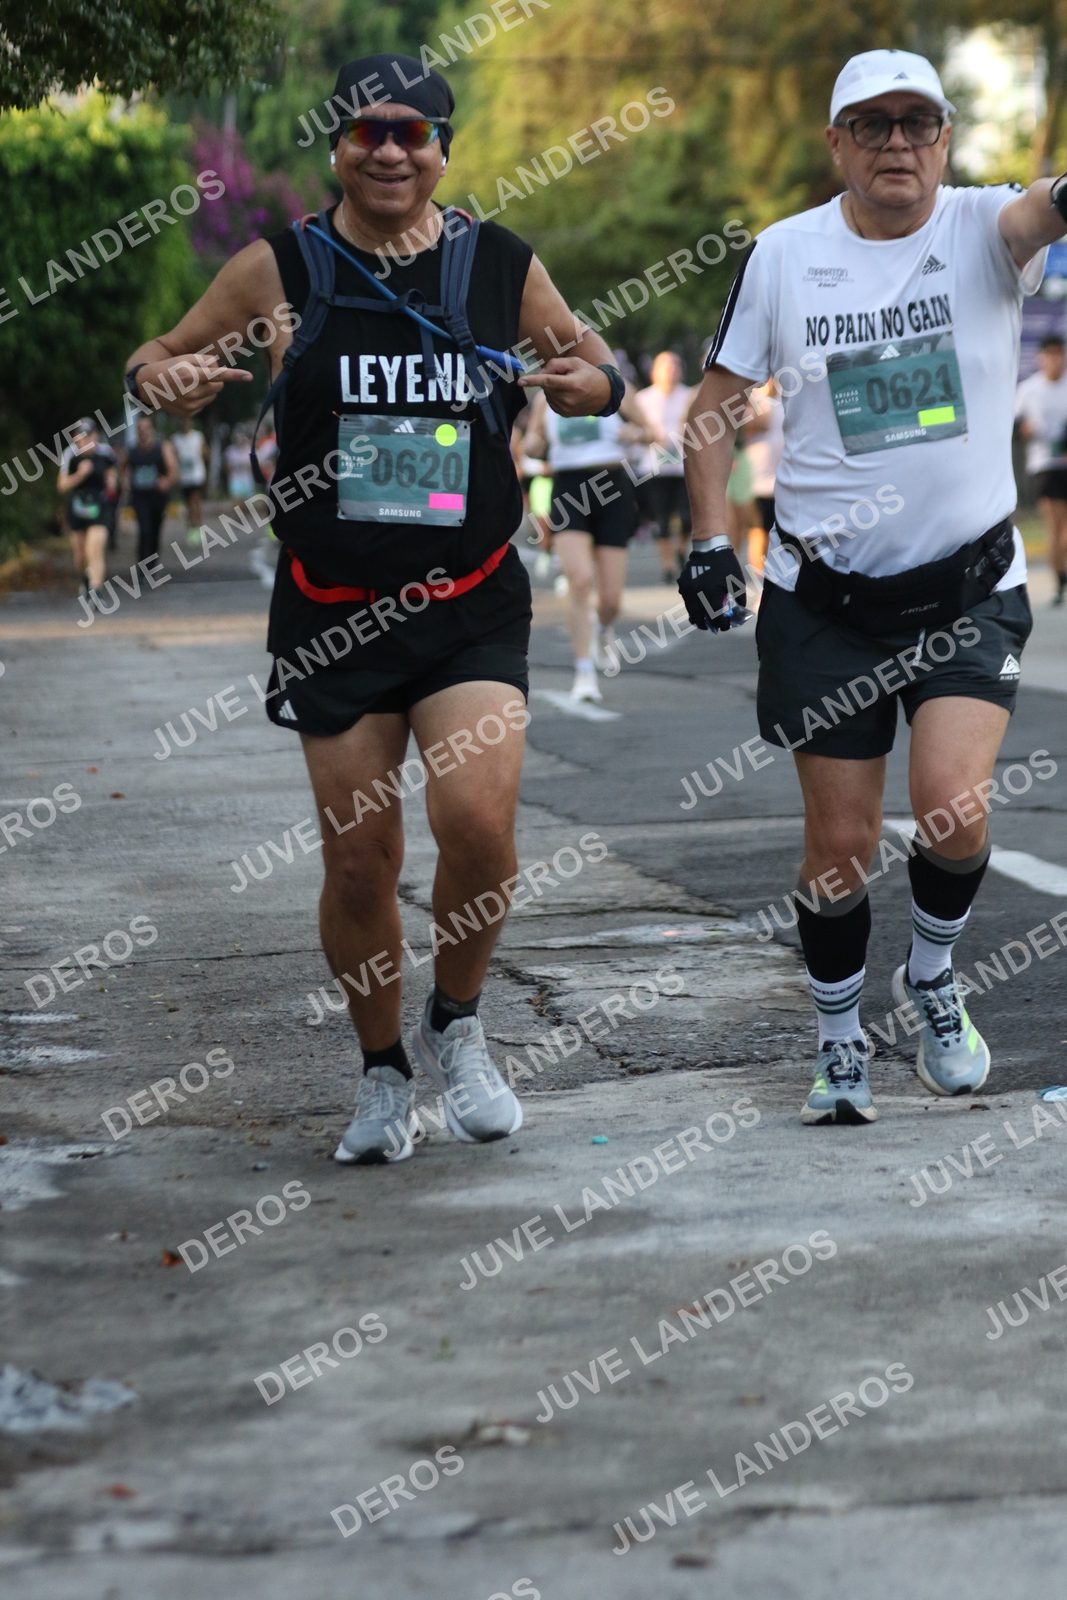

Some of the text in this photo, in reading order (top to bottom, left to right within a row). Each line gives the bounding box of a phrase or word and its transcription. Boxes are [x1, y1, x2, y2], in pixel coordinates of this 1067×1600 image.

[805, 294, 953, 347] NO PAIN NO GAIN
[866, 363, 959, 415] 0621
[884, 428, 928, 443] SAMSUNG
[370, 448, 464, 491] 0620
[378, 507, 422, 518] SAMSUNG
